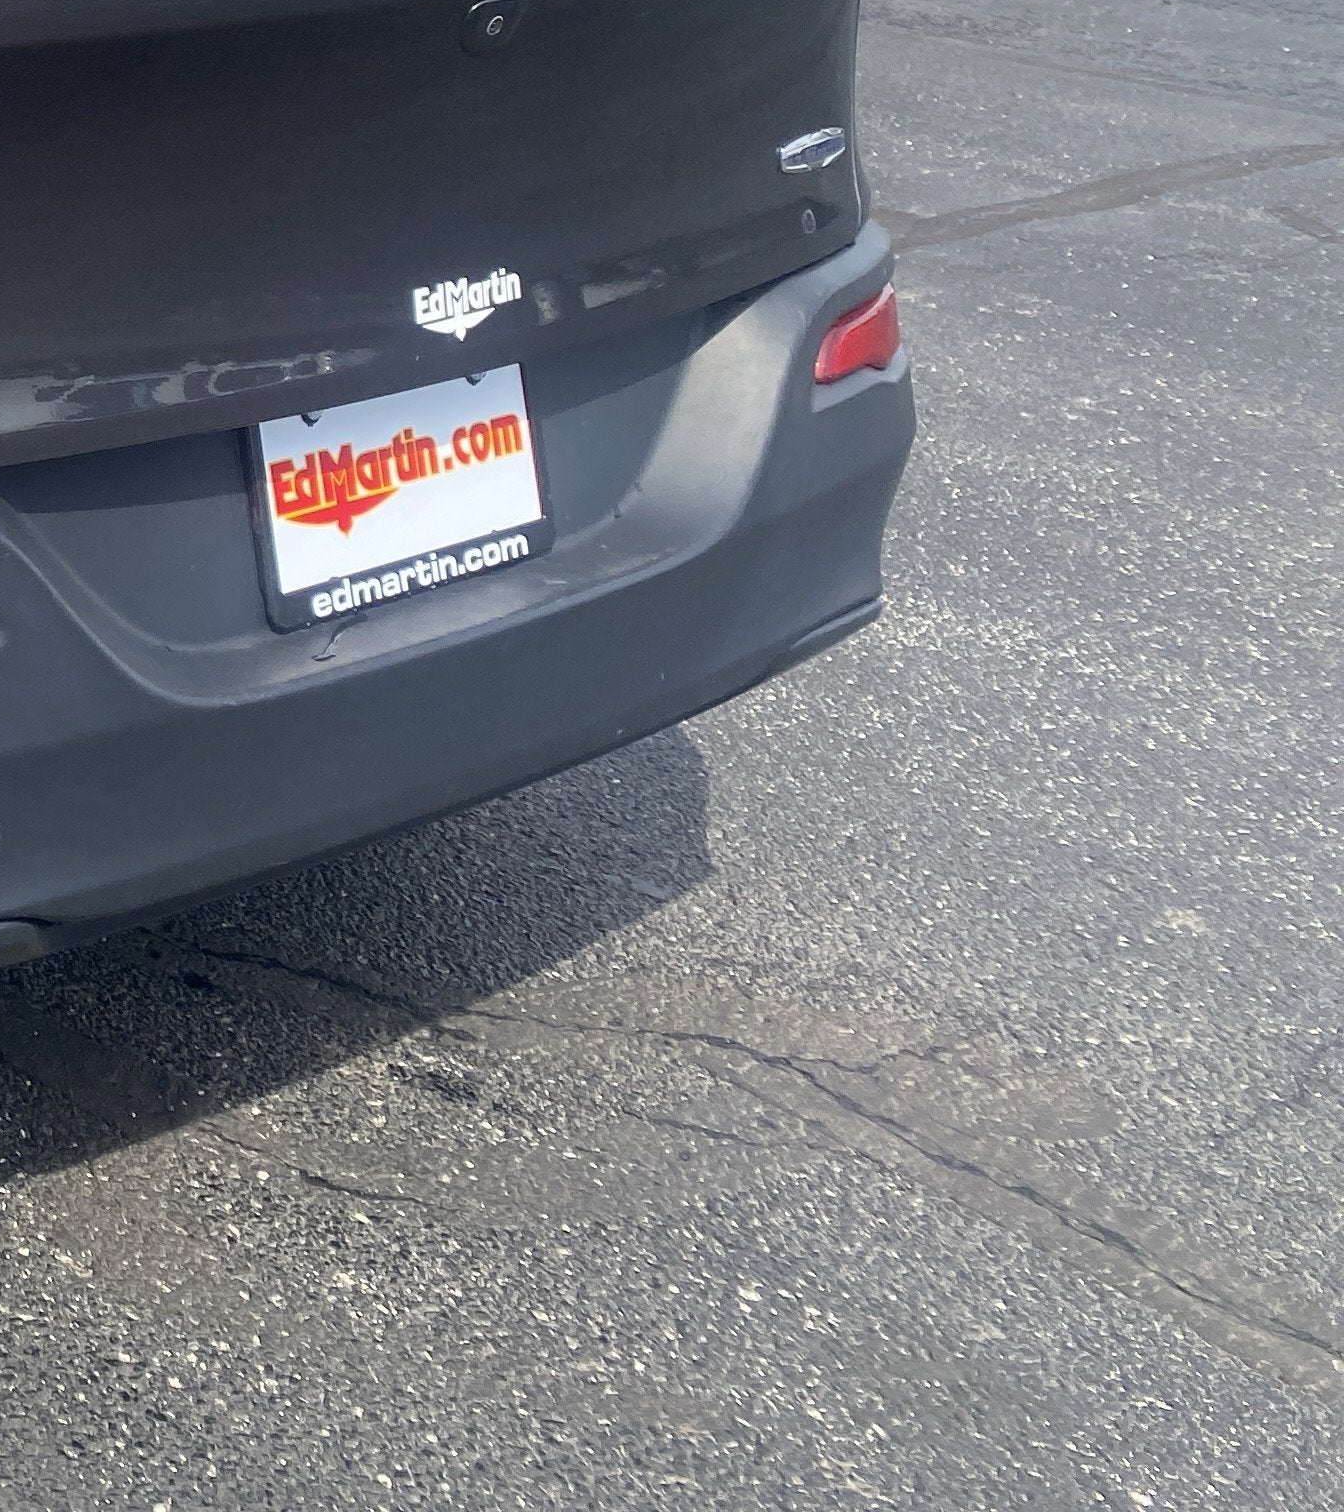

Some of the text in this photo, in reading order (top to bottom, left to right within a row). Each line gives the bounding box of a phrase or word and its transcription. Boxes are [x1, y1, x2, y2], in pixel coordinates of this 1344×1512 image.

[415, 268, 522, 325] EdMartin
[269, 414, 523, 519] EdMartin.com
[313, 534, 529, 619] edmartin.com
